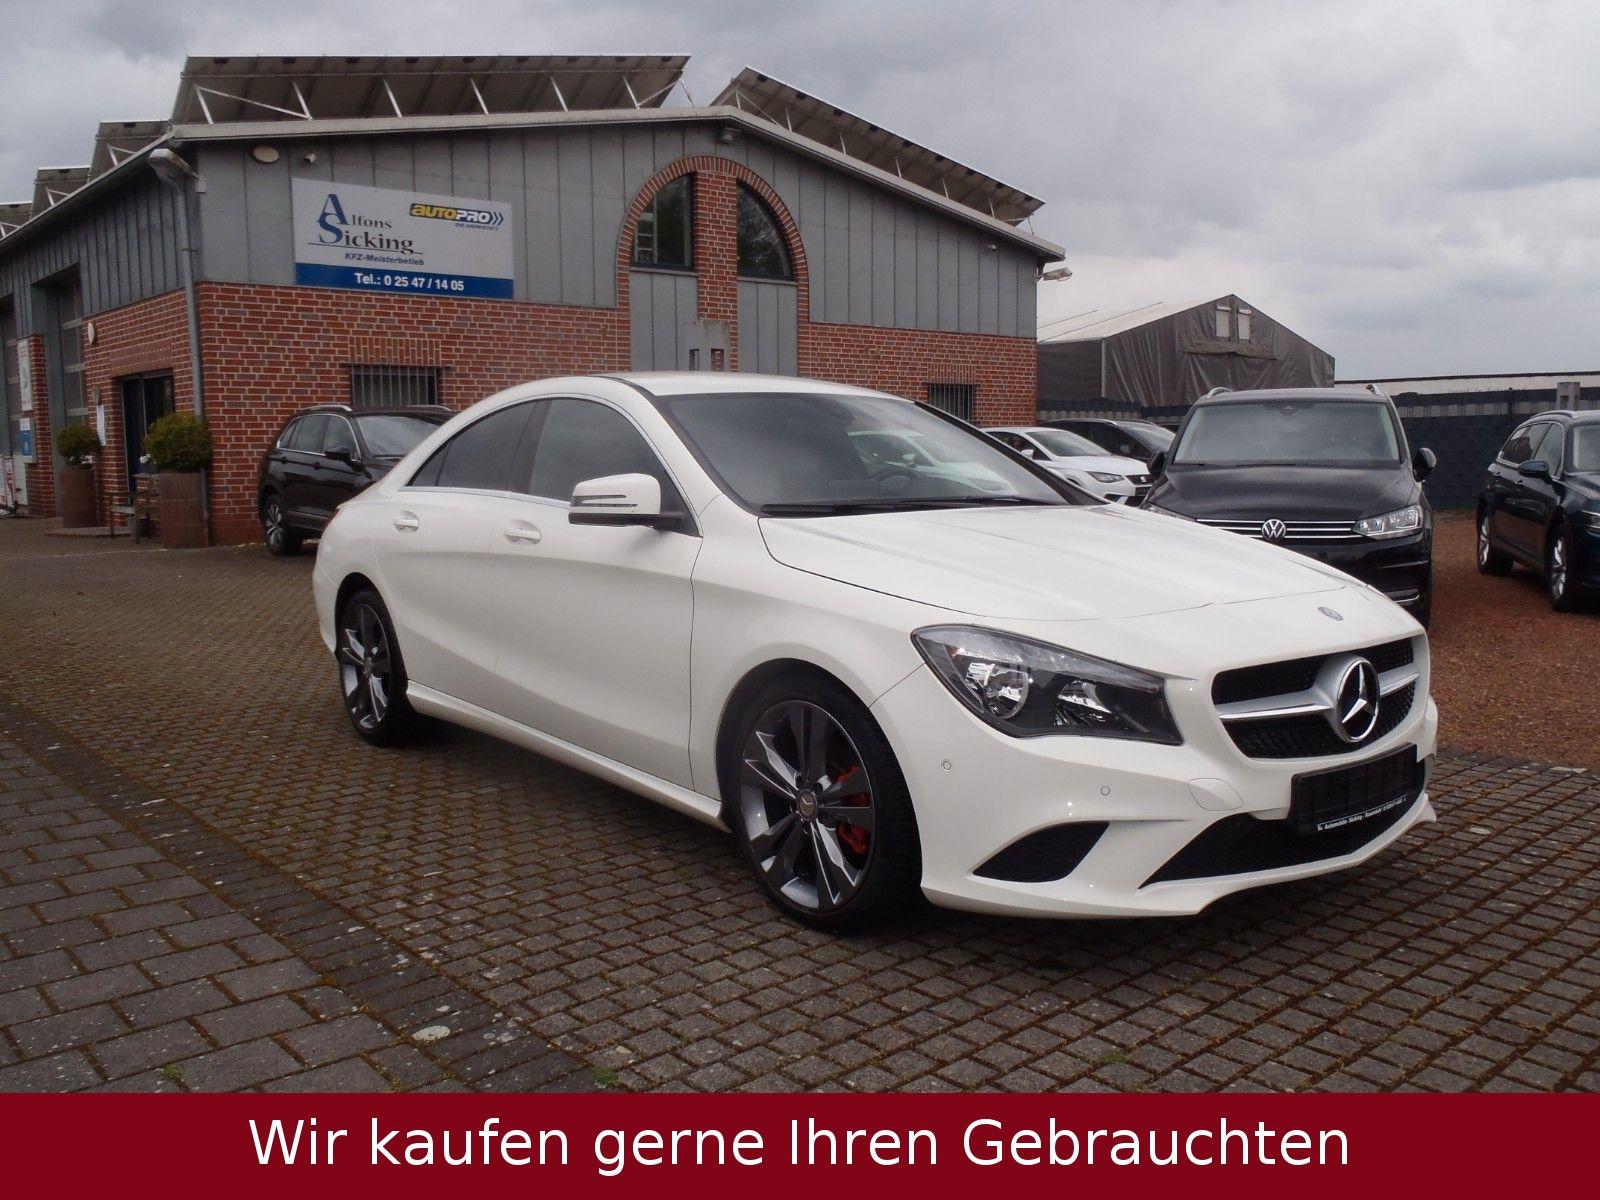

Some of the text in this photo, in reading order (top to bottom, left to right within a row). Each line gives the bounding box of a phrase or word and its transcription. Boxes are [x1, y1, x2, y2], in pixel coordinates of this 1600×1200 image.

[319, 214, 415, 255] Sicking
[354, 272, 382, 285] Tel.:
[384, 275, 392, 286] 0
[394, 276, 409, 287] 25
[411, 277, 426, 288] 47
[435, 279, 449, 290] 14
[450, 280, 465, 291] 05
